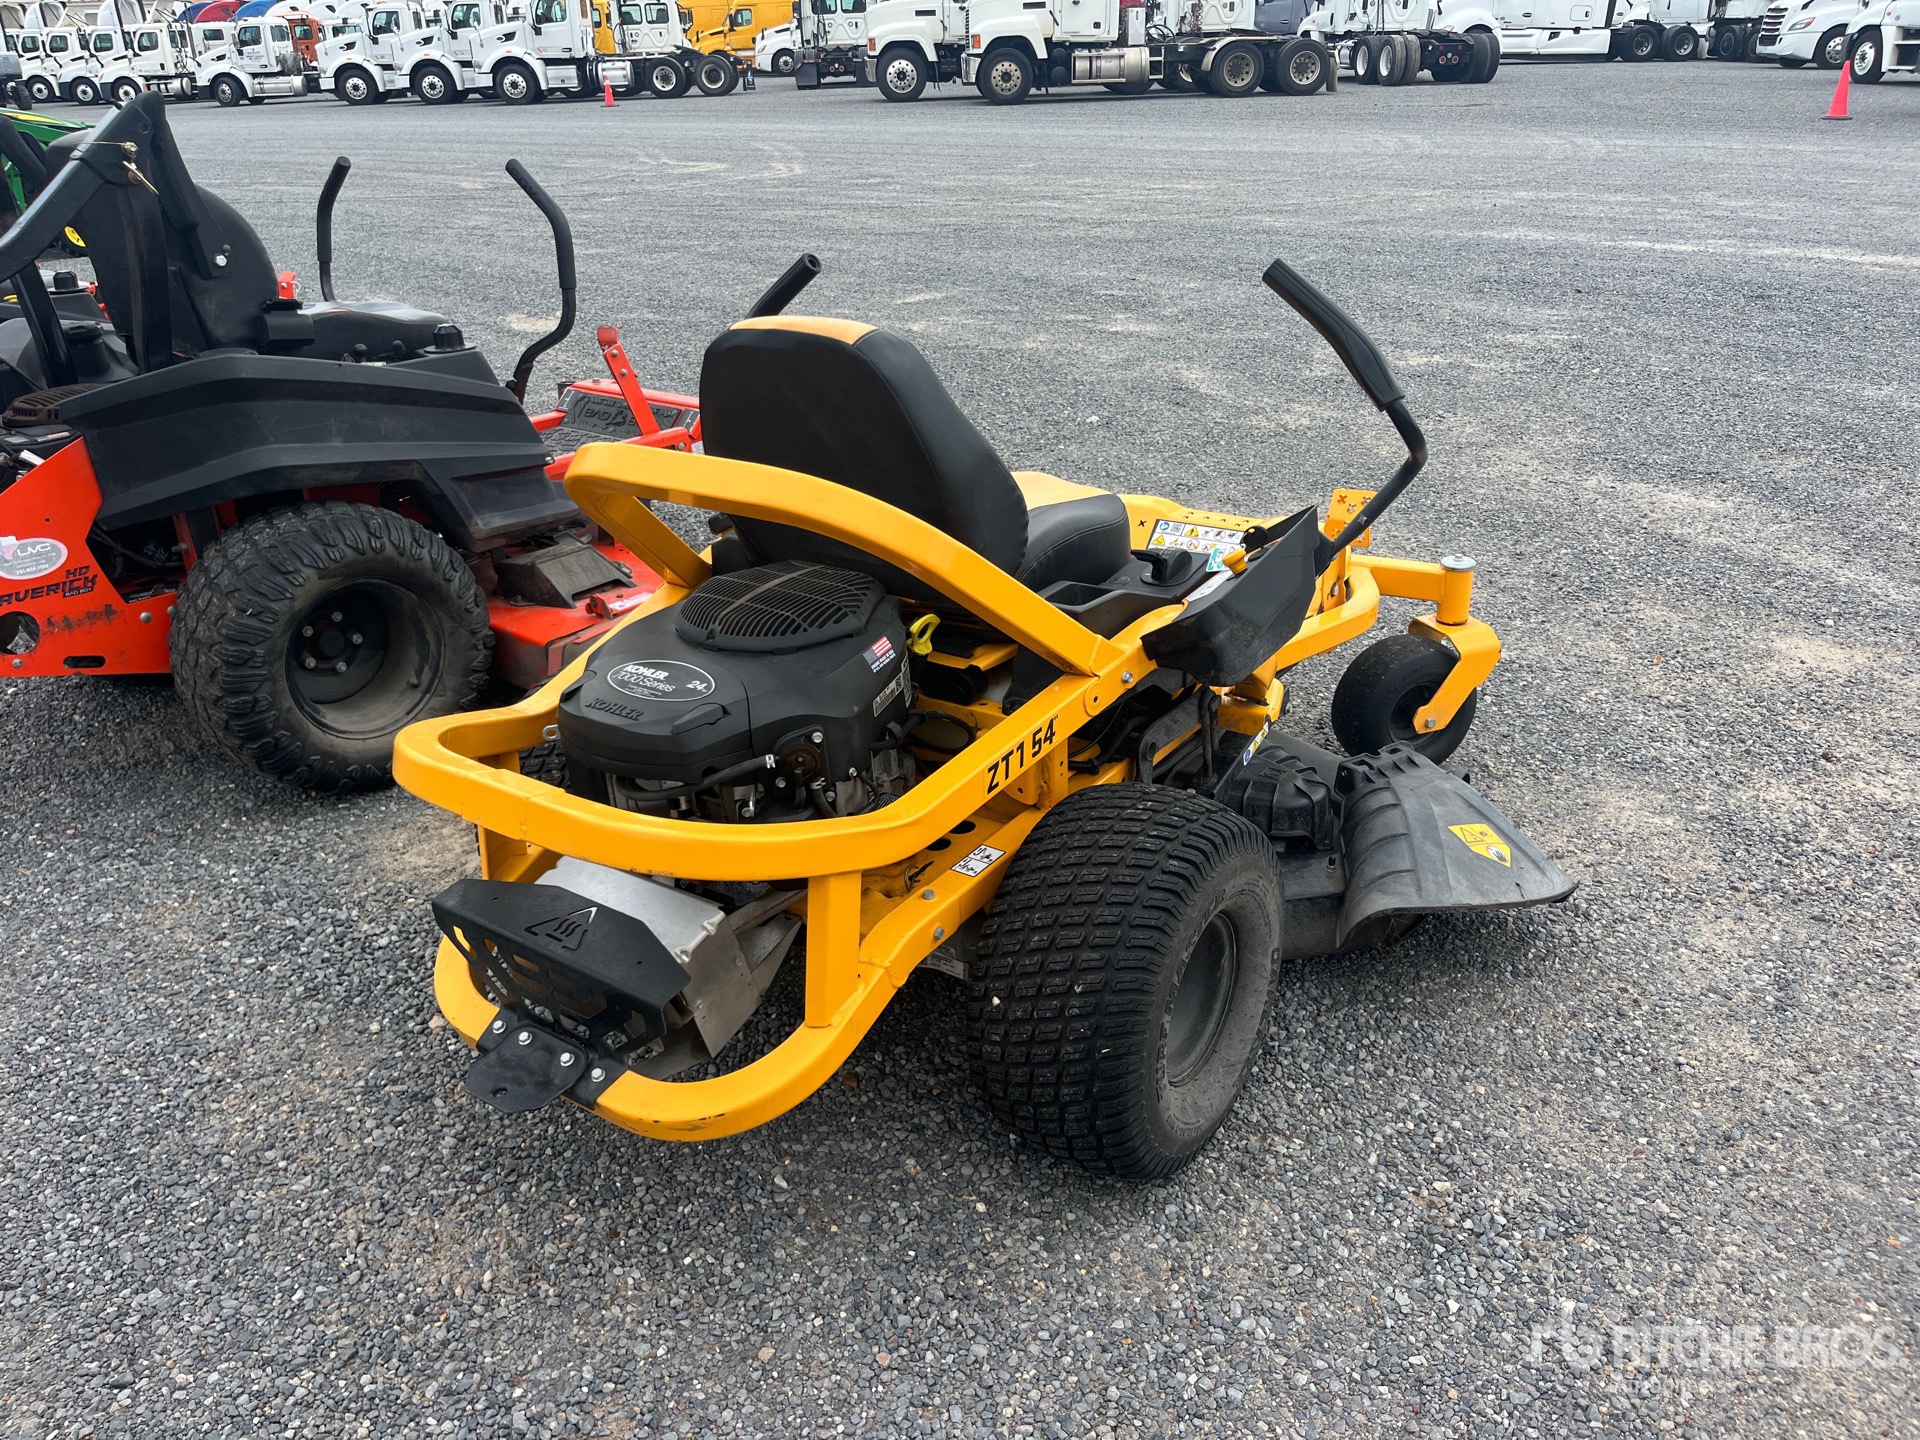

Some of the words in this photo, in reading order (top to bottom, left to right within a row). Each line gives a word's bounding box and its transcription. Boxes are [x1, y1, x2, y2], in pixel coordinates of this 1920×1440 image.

[65, 565, 91, 578] HD
[612, 671, 643, 683] 7000
[639, 677, 676, 692] Series
[623, 665, 670, 680] KOHLER
[686, 681, 708, 691] 24
[586, 698, 645, 721] KOHLER
[987, 740, 1025, 795] ZT1
[1031, 717, 1056, 758] 54
